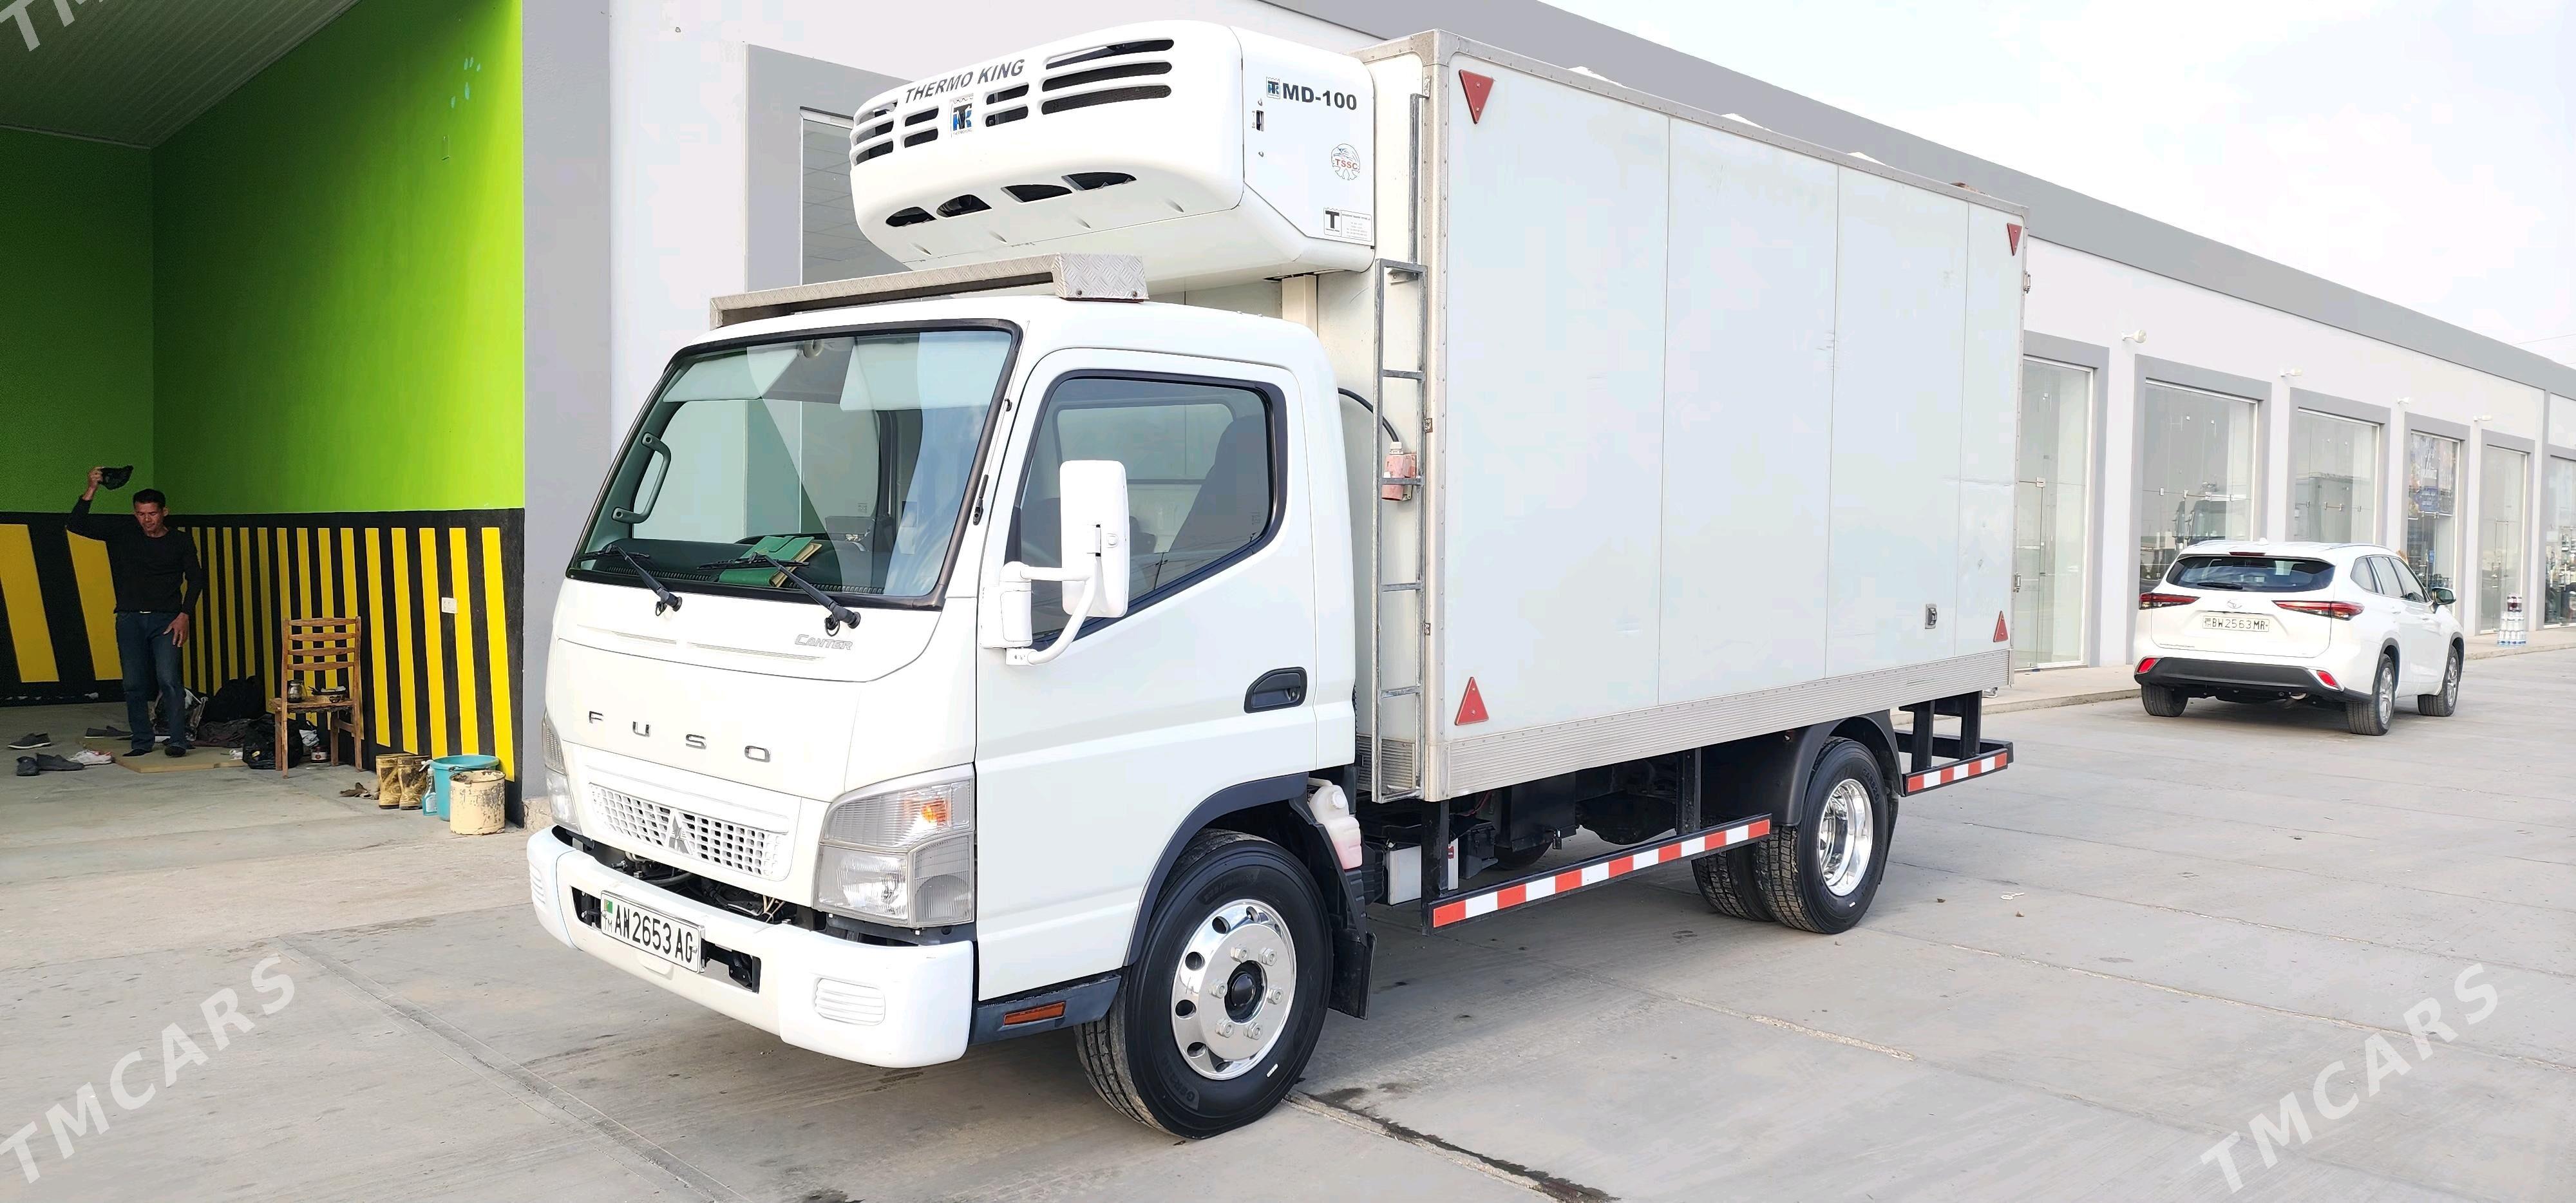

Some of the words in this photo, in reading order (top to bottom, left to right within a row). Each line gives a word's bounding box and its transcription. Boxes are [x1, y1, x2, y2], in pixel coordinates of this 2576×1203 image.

[905, 71, 974, 104] THERMO
[977, 59, 1025, 84] KING
[1282, 82, 1357, 111] MD-100
[1335, 158, 1358, 170] TSSC
[589, 710, 771, 763] FUSO
